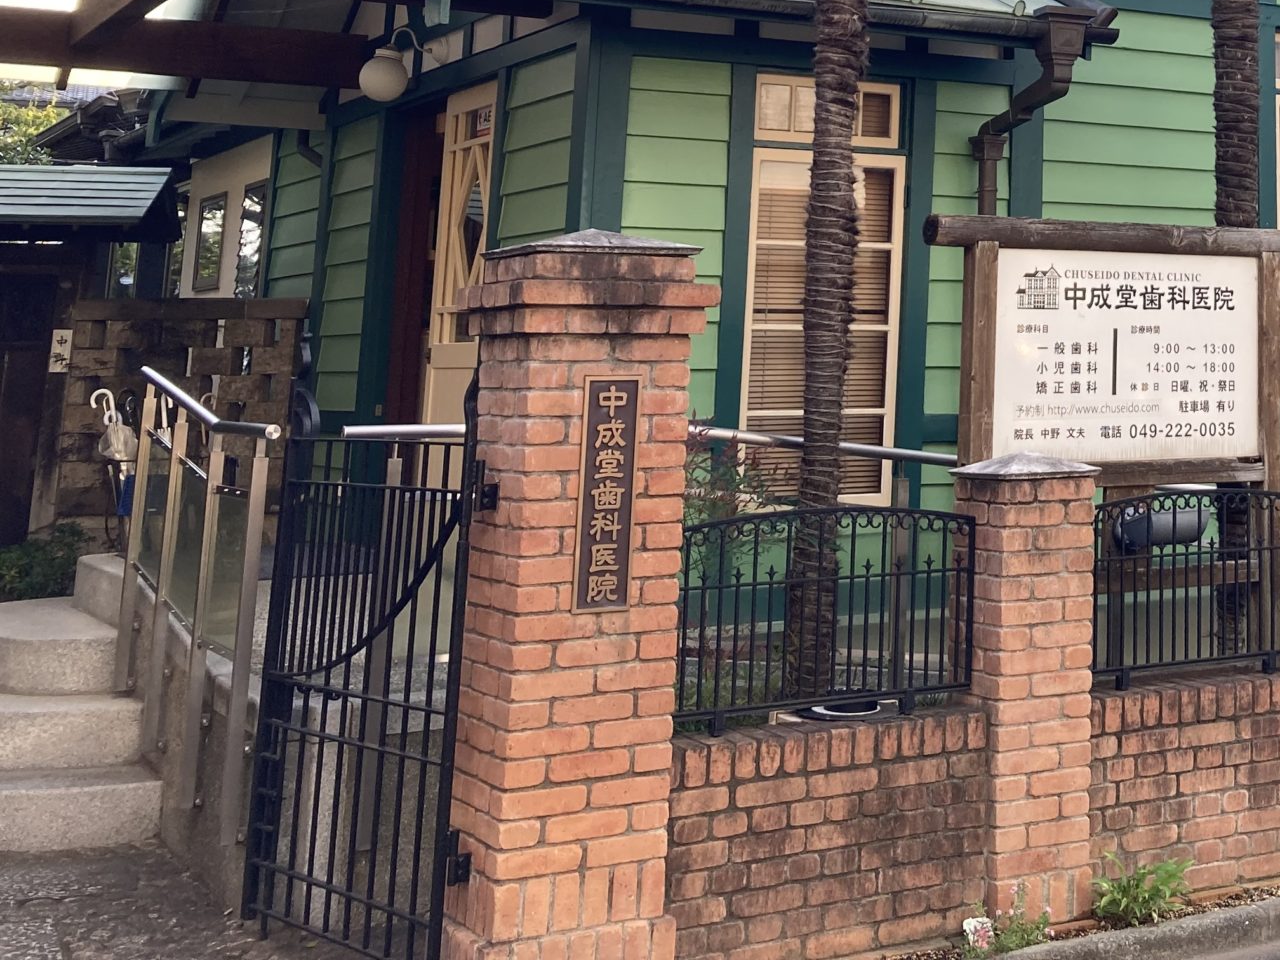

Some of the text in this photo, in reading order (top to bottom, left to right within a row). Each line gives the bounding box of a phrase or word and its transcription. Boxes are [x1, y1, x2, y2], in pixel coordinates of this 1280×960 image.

[1064, 269, 1202, 282] CHUSEIDO DENTAL CLINIC
[1064, 282, 1235, 311] 中成堂歯科医院
[1016, 324, 1049, 334] 診療科目
[1130, 325, 1161, 335] 診療時間
[1037, 341, 1098, 355] 一般歯科
[1153, 343, 1180, 354] 9:00
[1203, 343, 1235, 354] 13:00
[1036, 361, 1098, 375] 小児歯科
[1146, 362, 1180, 373] 14:00
[1203, 362, 1235, 373] 18:00
[1035, 380, 1097, 395] 矯正歯科
[1015, 402, 1160, 418] 予約制 http://www.chuseido.com
[1178, 400, 1235, 413] 駐車場 有り
[1013, 422, 1236, 440] 院長 中野 文夫 電話 049-222-0035
[586, 385, 628, 603] 中成堂歯科医院
